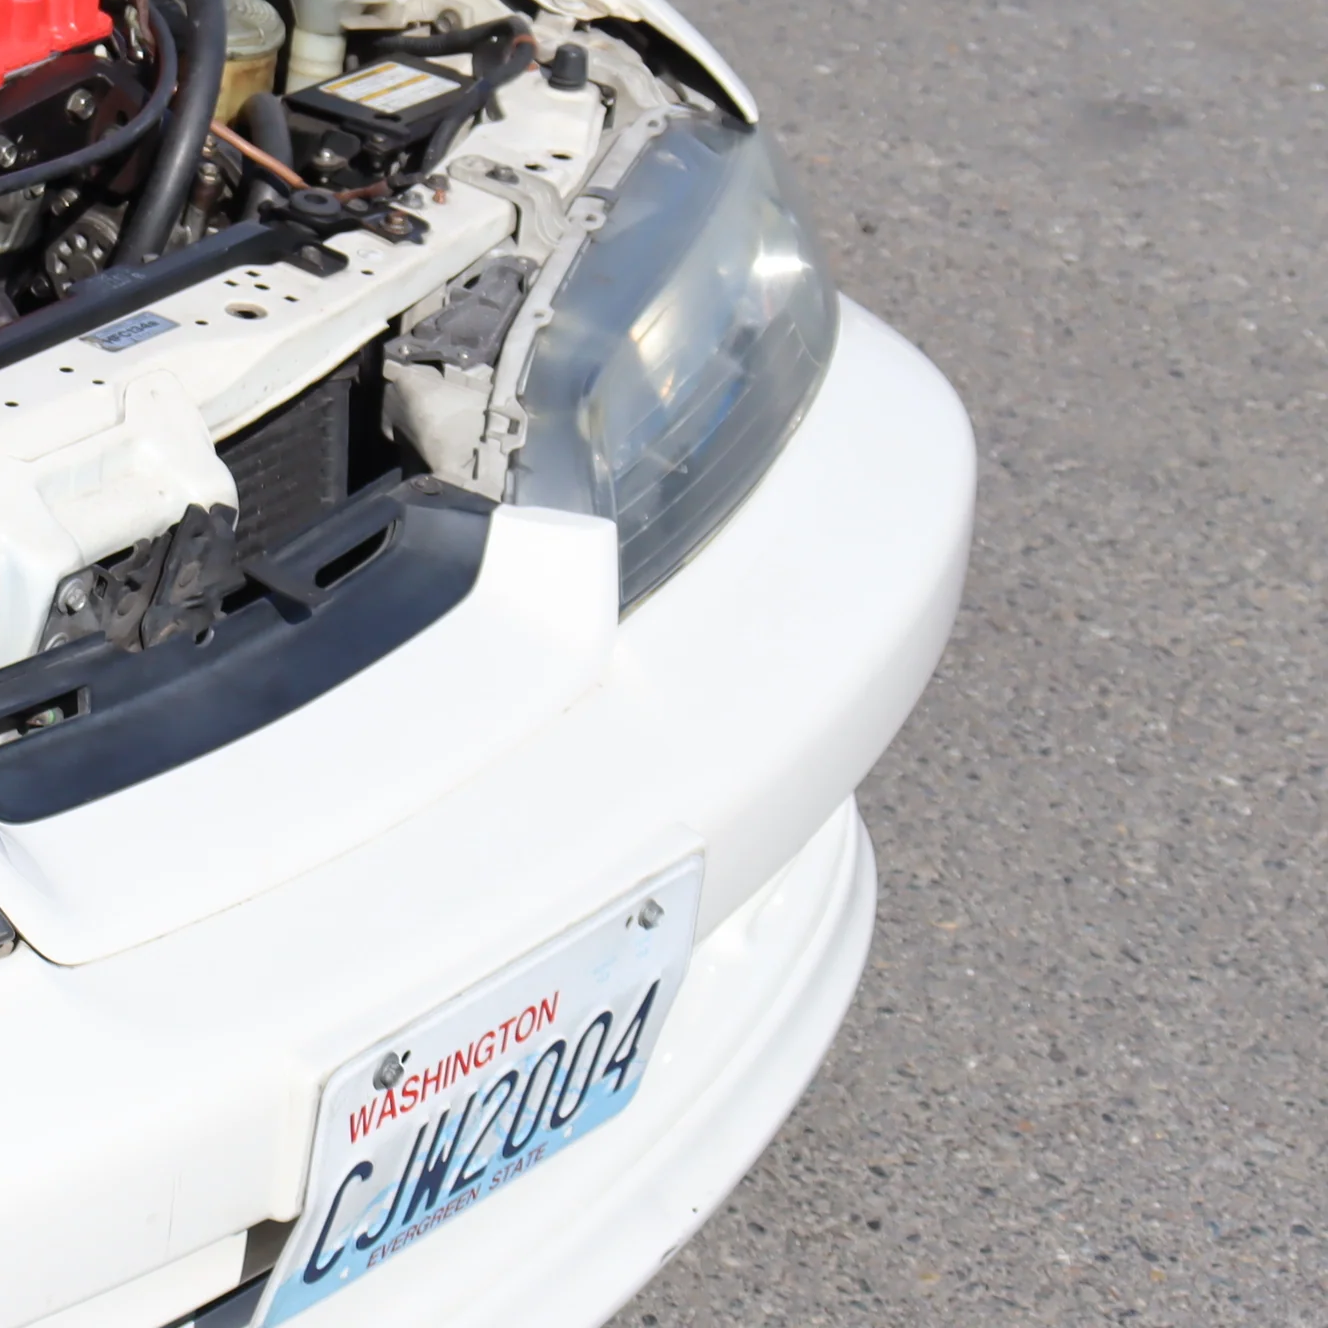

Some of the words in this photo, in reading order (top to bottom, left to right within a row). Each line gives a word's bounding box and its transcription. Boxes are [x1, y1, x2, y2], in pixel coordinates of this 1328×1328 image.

[302, 978, 662, 1285] CJW2004
[348, 991, 560, 1145] WASHINGTON
[366, 1186, 482, 1269] EVERGREEN
[488, 1141, 549, 1191] STATE
